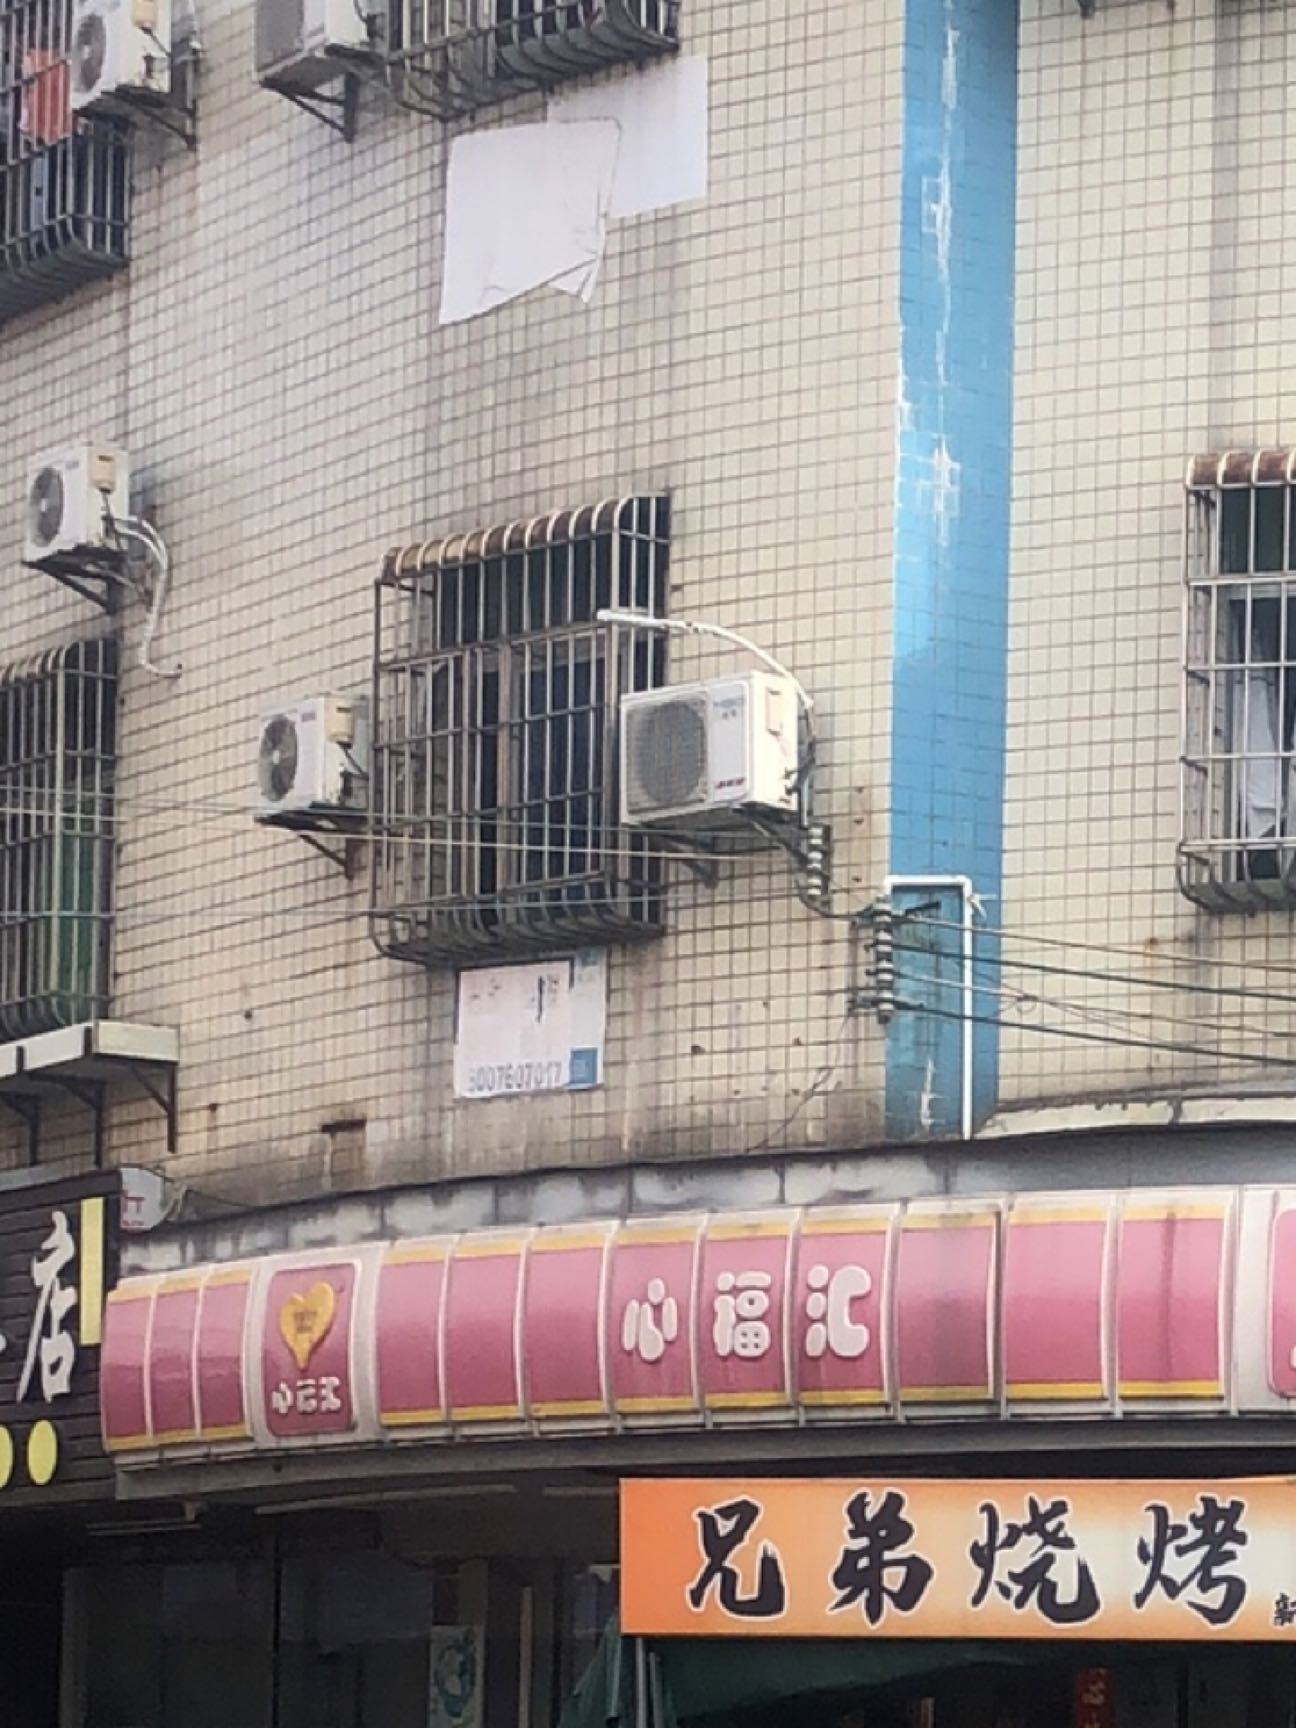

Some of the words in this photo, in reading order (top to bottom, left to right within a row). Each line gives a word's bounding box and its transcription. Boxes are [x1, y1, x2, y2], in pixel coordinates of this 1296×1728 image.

[622, 1263, 875, 1363] 心福汇
[271, 1375, 343, 1415] 心福汇
[687, 1489, 1251, 1628] 兄弟烧烤
